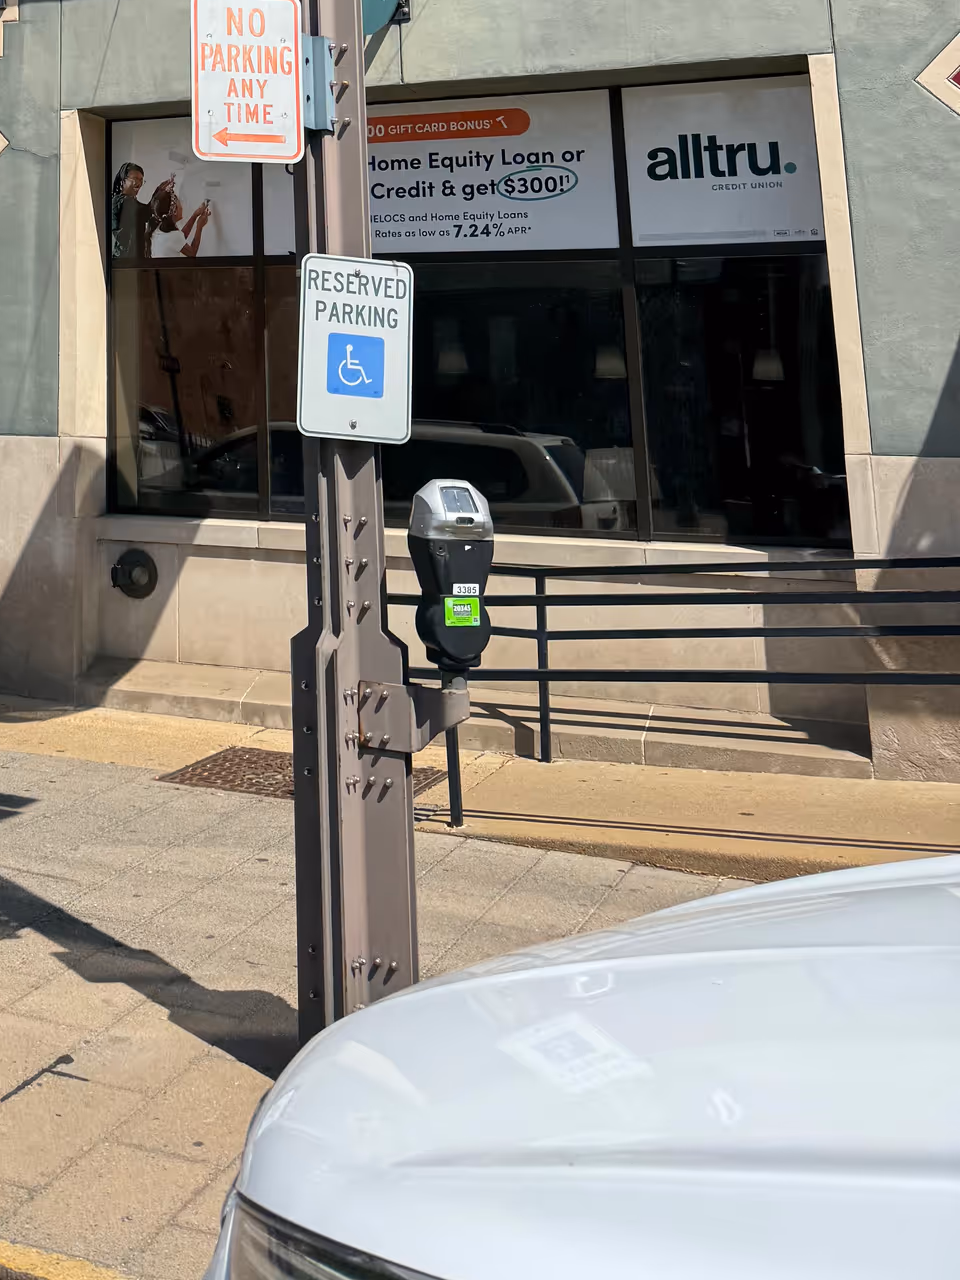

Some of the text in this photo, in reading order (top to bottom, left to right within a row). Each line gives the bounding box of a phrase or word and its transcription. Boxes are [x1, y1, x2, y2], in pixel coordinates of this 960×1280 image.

[227, 7, 265, 37] NO
[201, 43, 292, 75] PARKING
[227, 78, 268, 99] ANY
[224, 103, 273, 124] TIME
[388, 124, 413, 134] GIFT
[415, 122, 447, 133] CARD
[428, 150, 494, 173] Equity
[501, 149, 554, 166] Loan
[561, 149, 585, 163] or
[371, 181, 435, 199] Credit
[441, 180, 456, 197] &
[462, 179, 497, 201] get
[711, 181, 783, 191] CREDIT UNION
[408, 213, 428, 222] and
[431, 212, 460, 221] Home
[463, 211, 495, 222] Equity
[498, 211, 528, 220] Loans
[375, 229, 402, 238] Rates
[419, 228, 436, 237] low
[439, 229, 450, 237] as
[453, 223, 505, 238] 7.24%
[308, 269, 407, 299] RESERVED
[315, 300, 398, 329] PARKING
[457, 586, 477, 595] 3385
